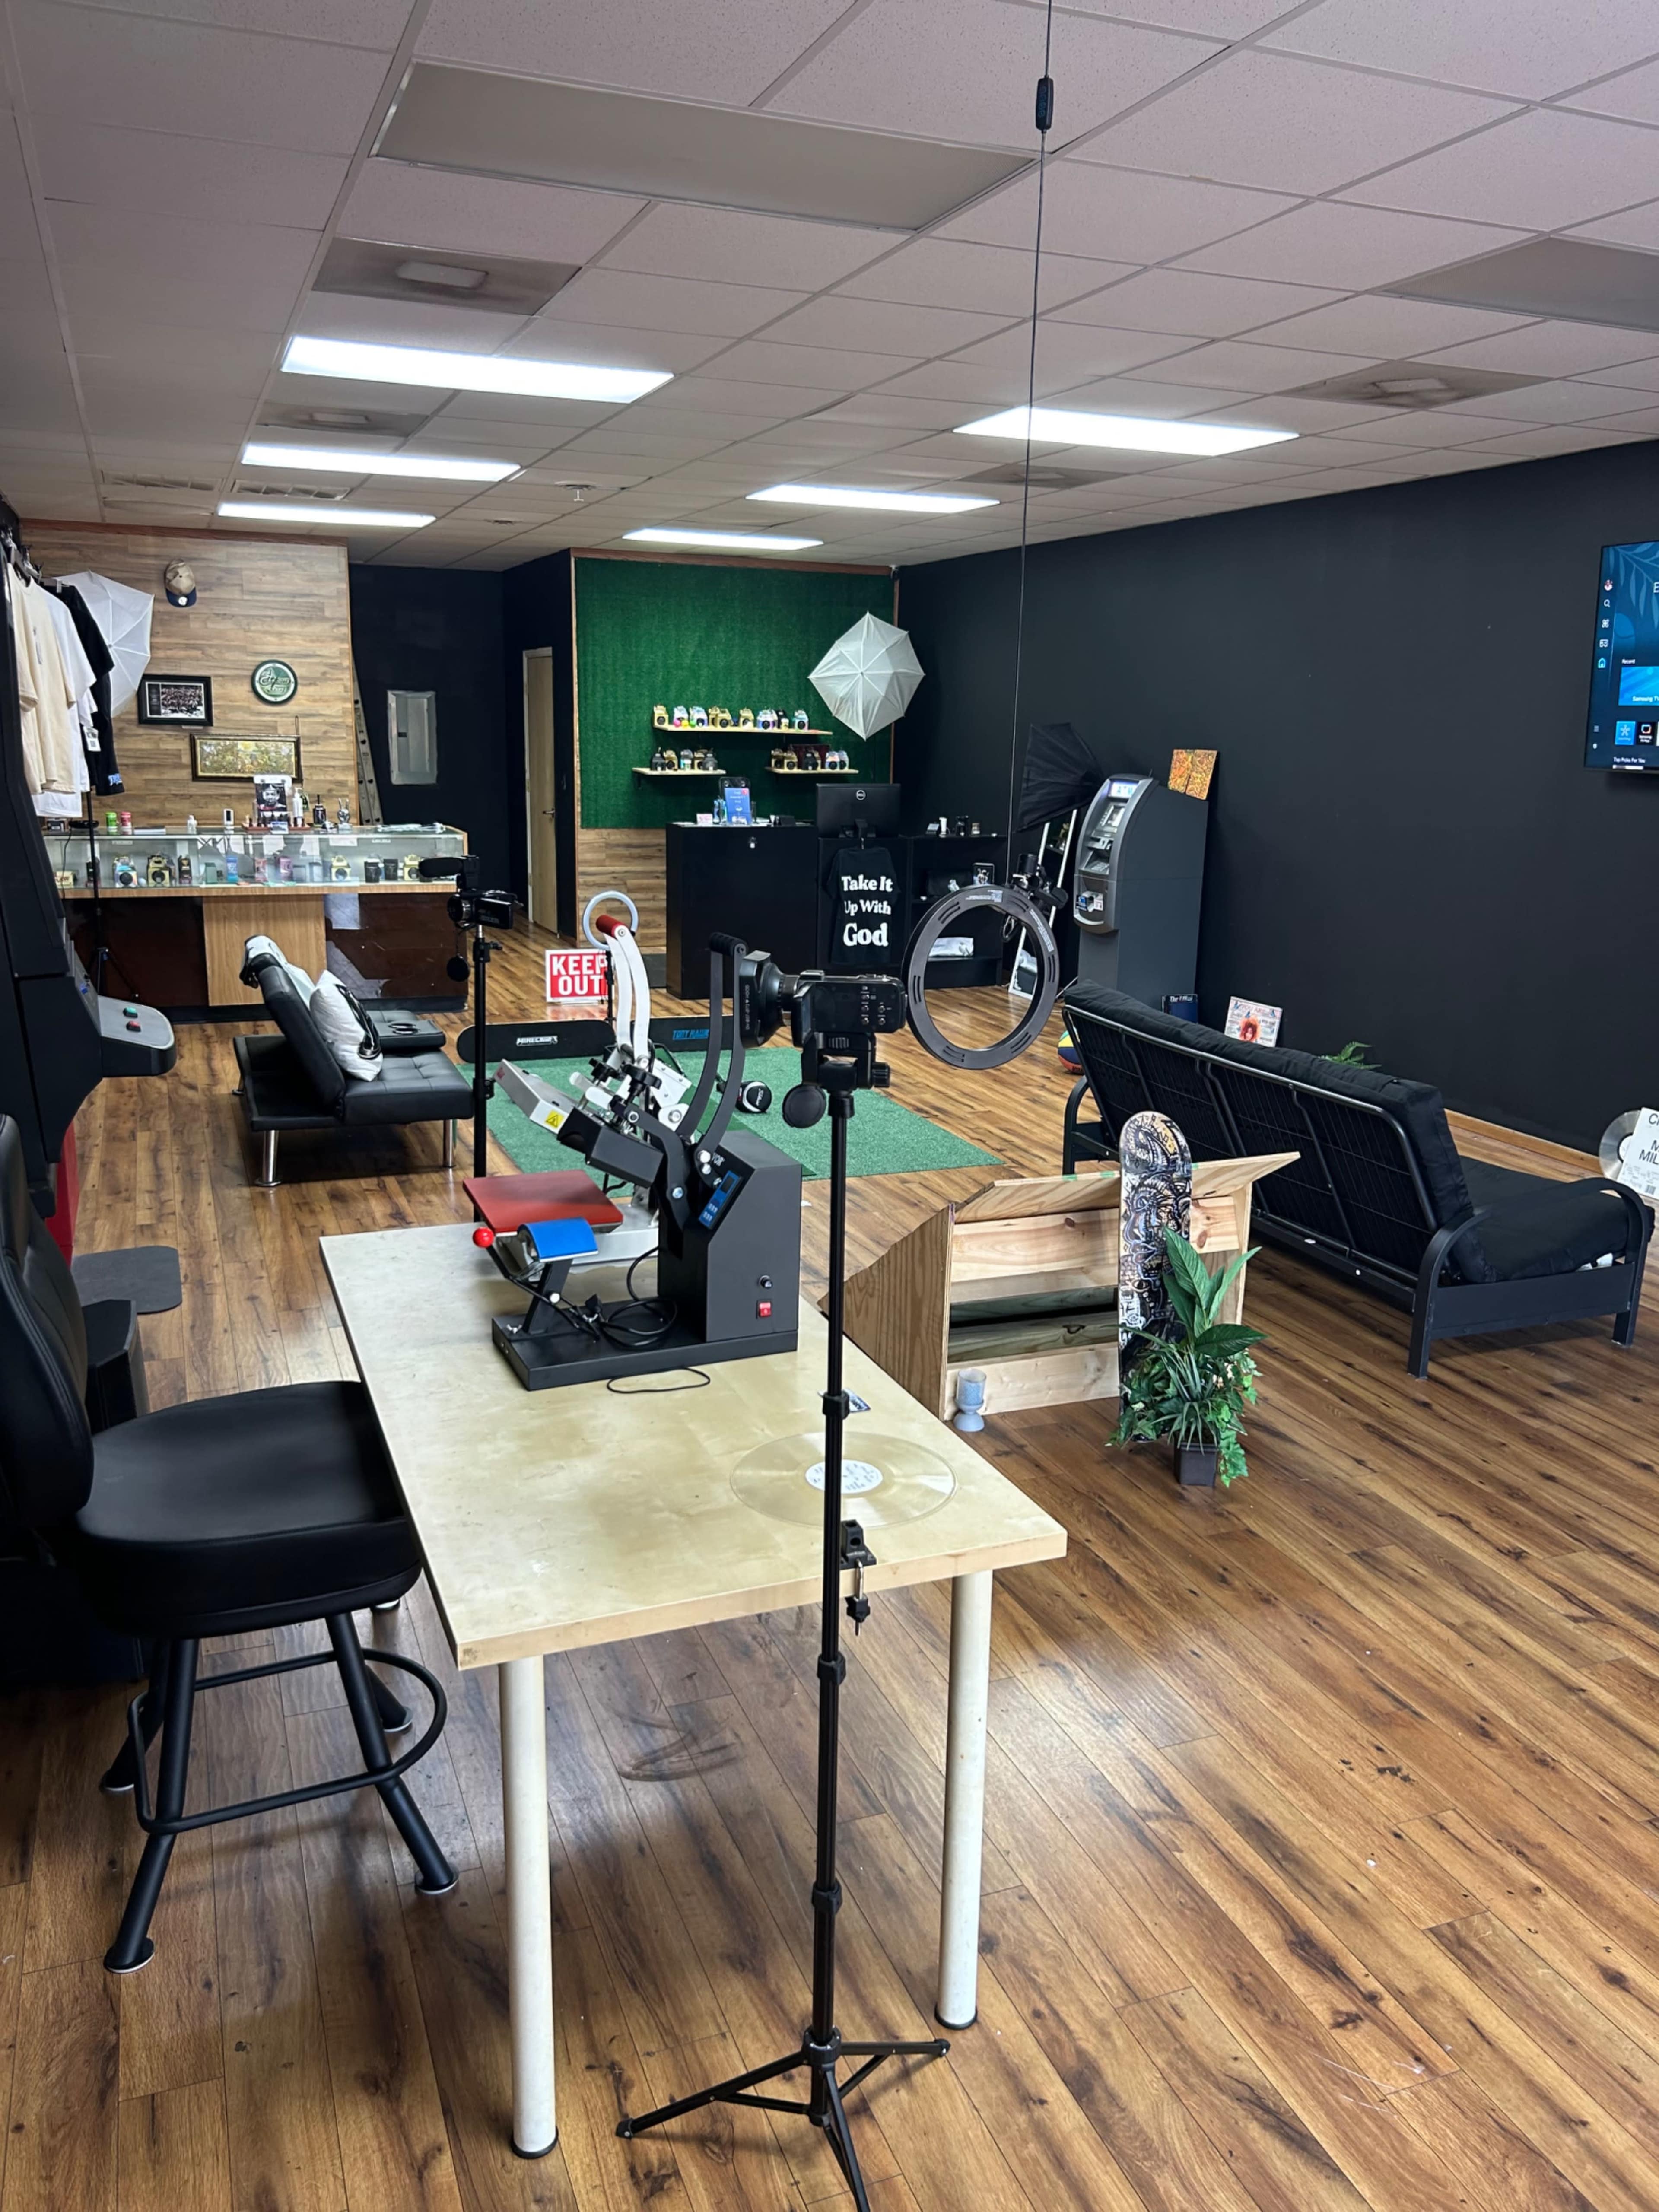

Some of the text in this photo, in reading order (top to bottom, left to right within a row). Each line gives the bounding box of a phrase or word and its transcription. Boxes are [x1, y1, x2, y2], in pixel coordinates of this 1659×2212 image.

[841, 874, 893, 892] Take It
[844, 899, 891, 916] Up With
[843, 922, 889, 947] God
[552, 955, 607, 976] KEEP
[558, 975, 603, 995] OUT
